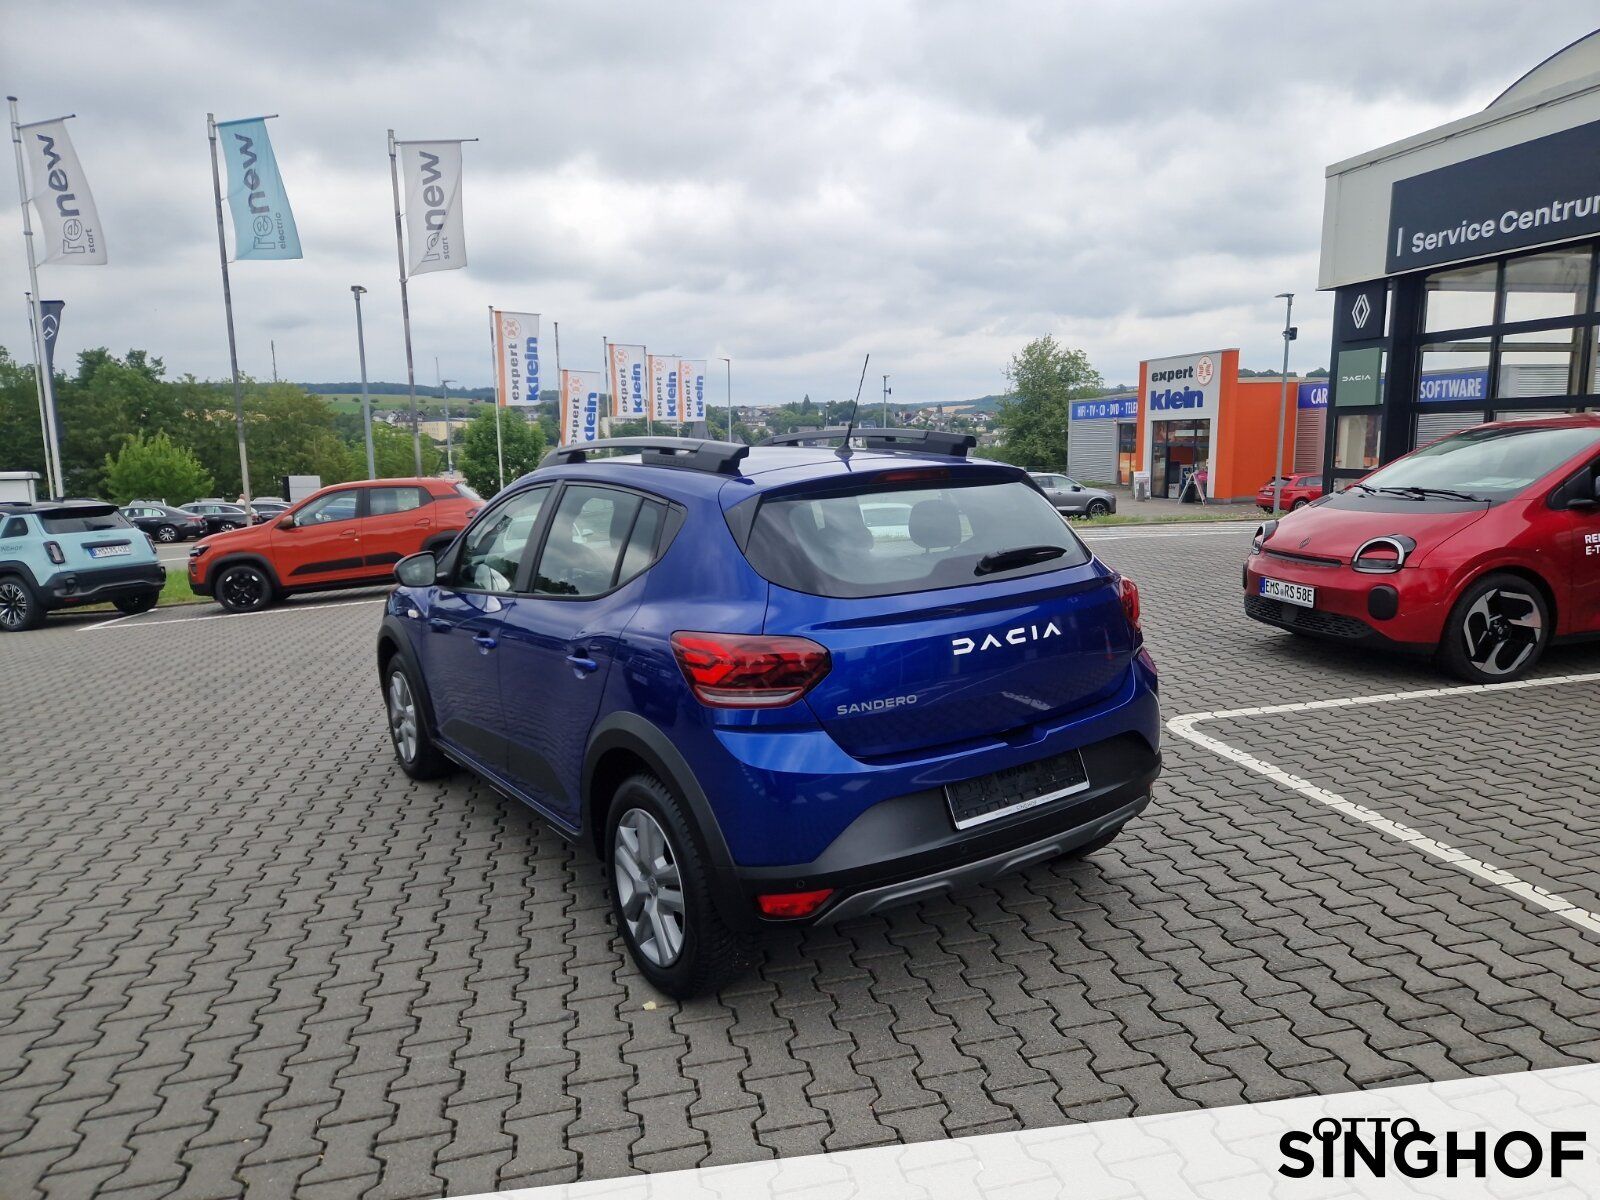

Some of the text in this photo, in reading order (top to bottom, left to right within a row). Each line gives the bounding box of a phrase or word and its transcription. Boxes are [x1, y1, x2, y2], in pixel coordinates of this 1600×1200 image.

[85, 228, 96, 253] start
[276, 212, 286, 249] electric
[1411, 219, 1495, 253] Service
[442, 236, 450, 259] start
[508, 343, 520, 400] expert
[524, 337, 539, 400] klein
[1151, 366, 1194, 382] expert
[1341, 374, 1371, 382] DACIA
[618, 367, 629, 413] expert
[631, 363, 643, 413] klein
[666, 371, 677, 417] klein
[695, 375, 704, 417] klein
[1150, 386, 1204, 410] klein
[1311, 387, 1328, 405] CAR
[1420, 378, 1482, 399] SOFTWARE
[1284, 584, 1295, 599] RS
[1296, 587, 1313, 603] 58E
[952, 622, 1062, 655] DACIA
[837, 694, 917, 715] SANDERO
